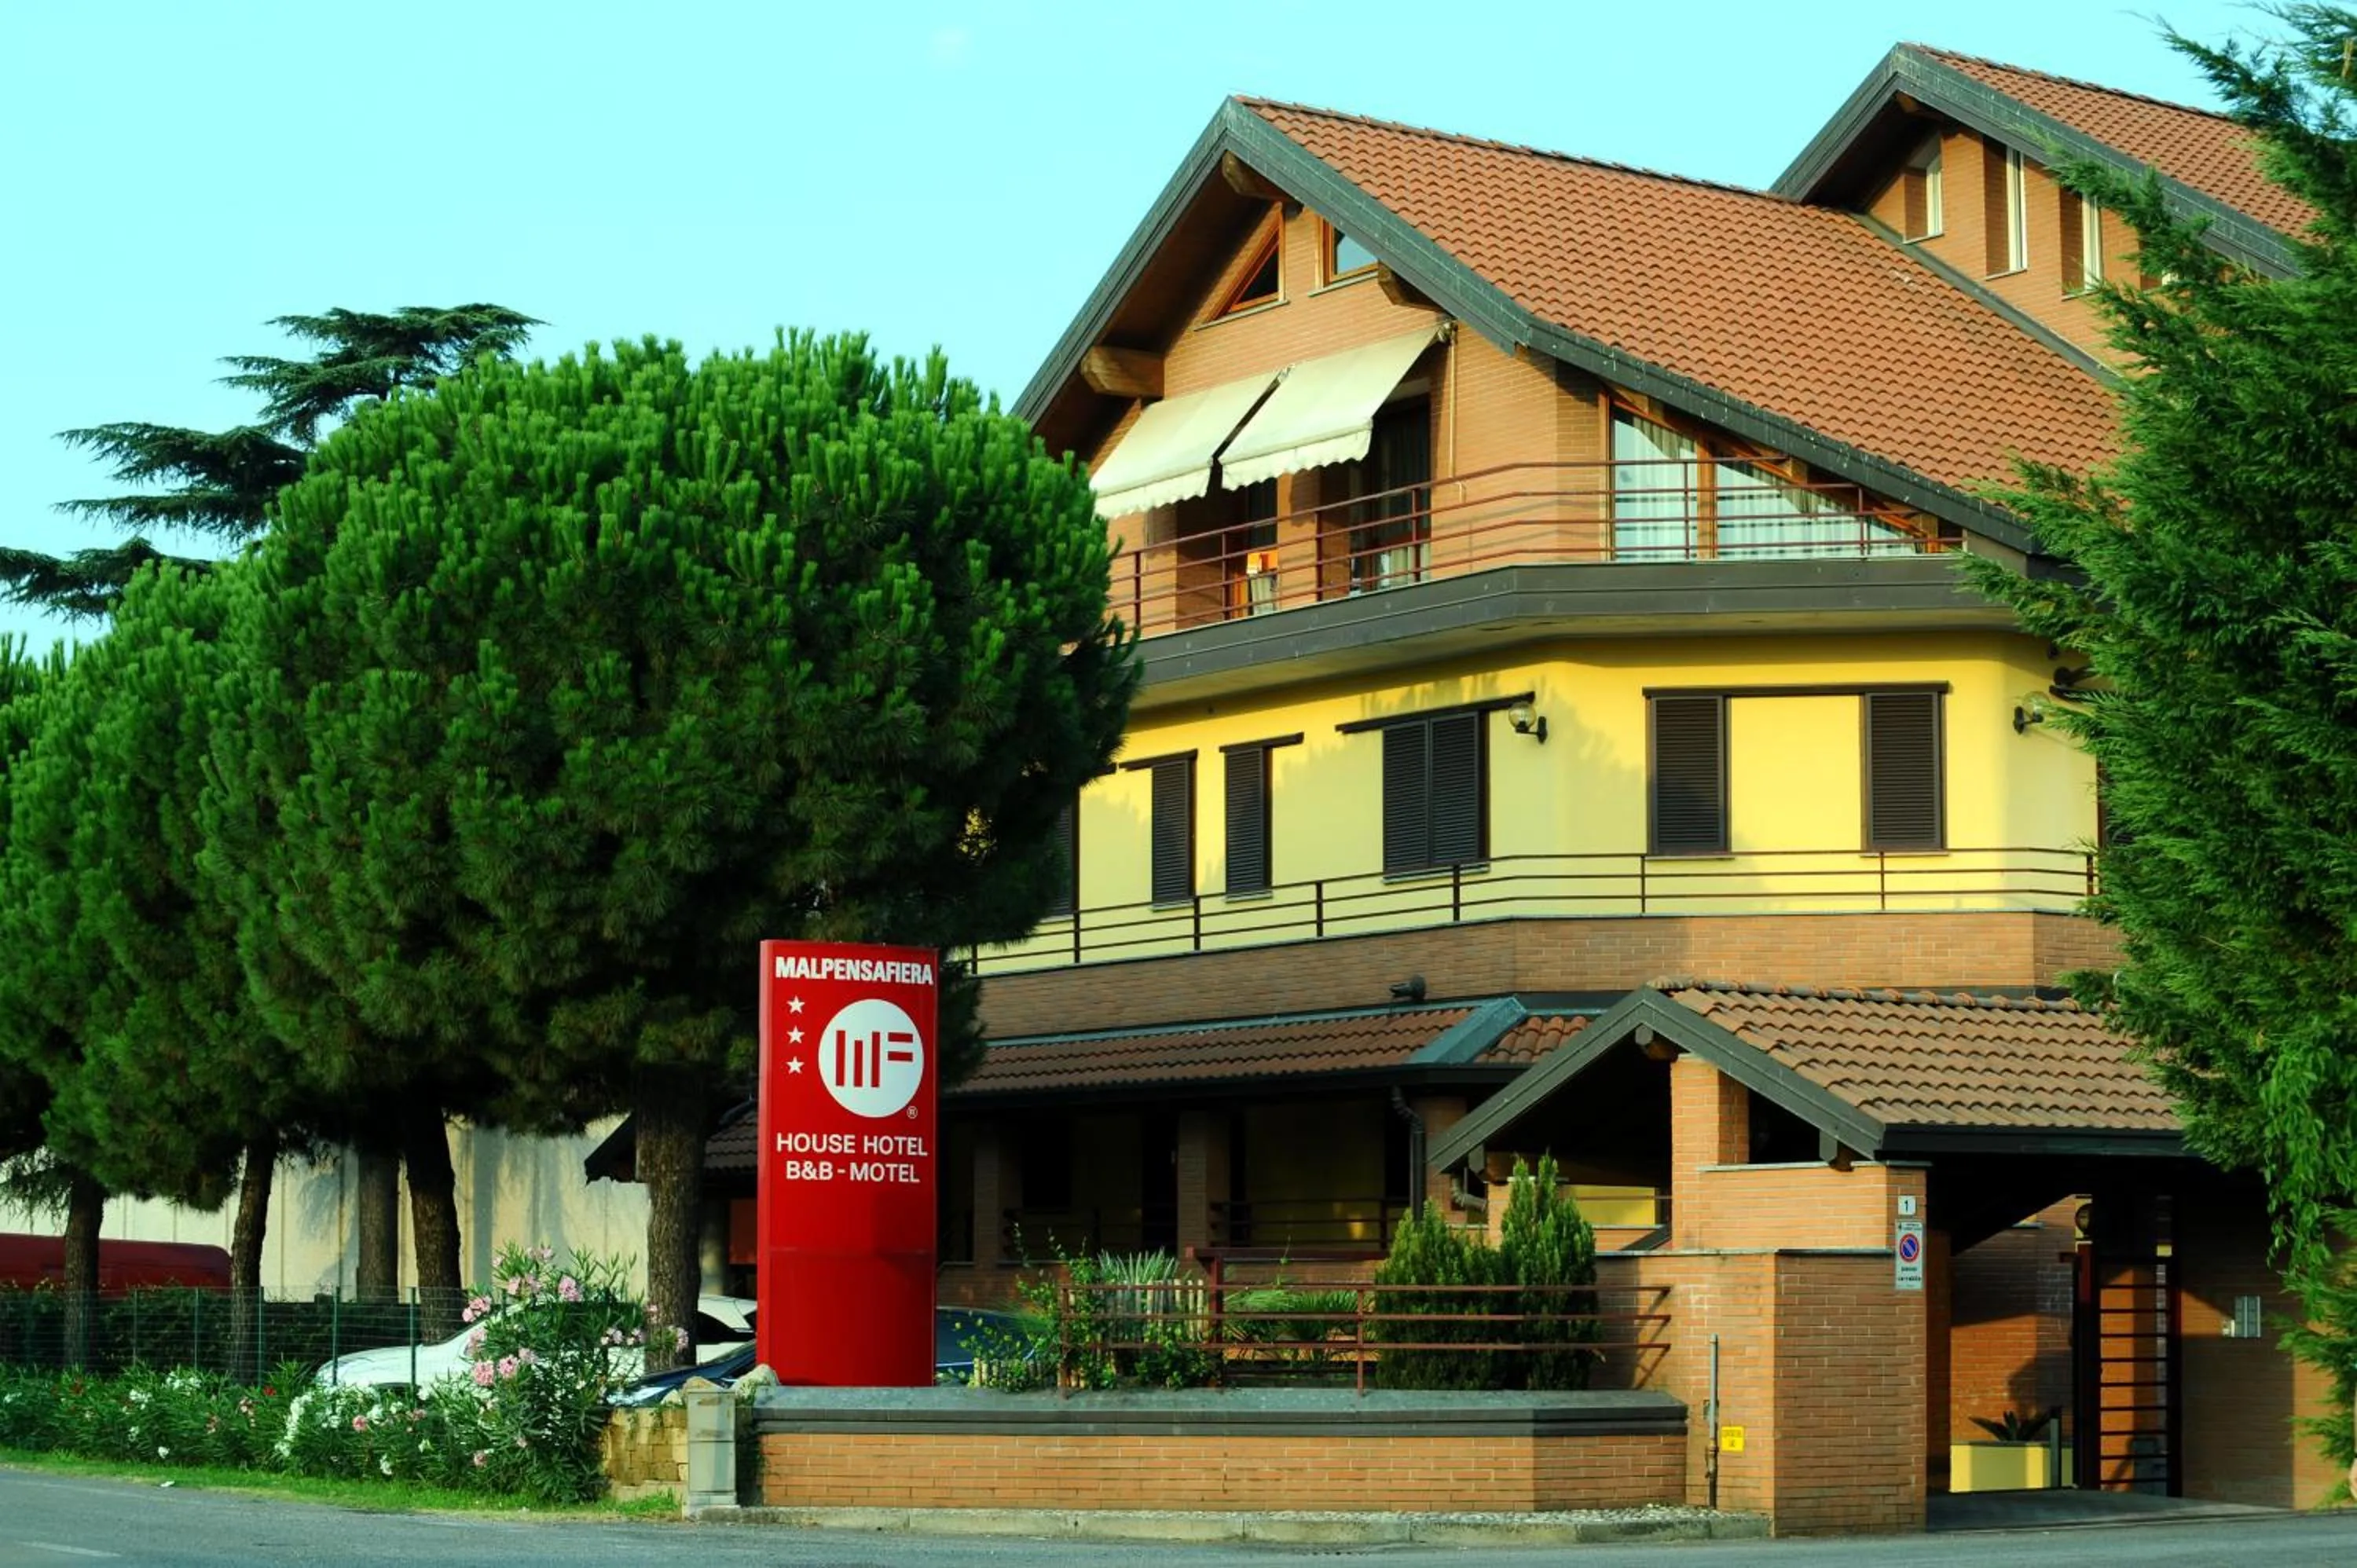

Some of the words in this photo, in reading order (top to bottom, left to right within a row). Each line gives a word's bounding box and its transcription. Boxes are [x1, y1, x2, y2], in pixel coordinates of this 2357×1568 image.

[775, 956, 934, 985] MALPENSAFIERA
[776, 1133, 856, 1154] HOUSE
[863, 1135, 928, 1156] HOTEL
[786, 1160, 834, 1181] B&B
[849, 1162, 921, 1183] MOTEL
